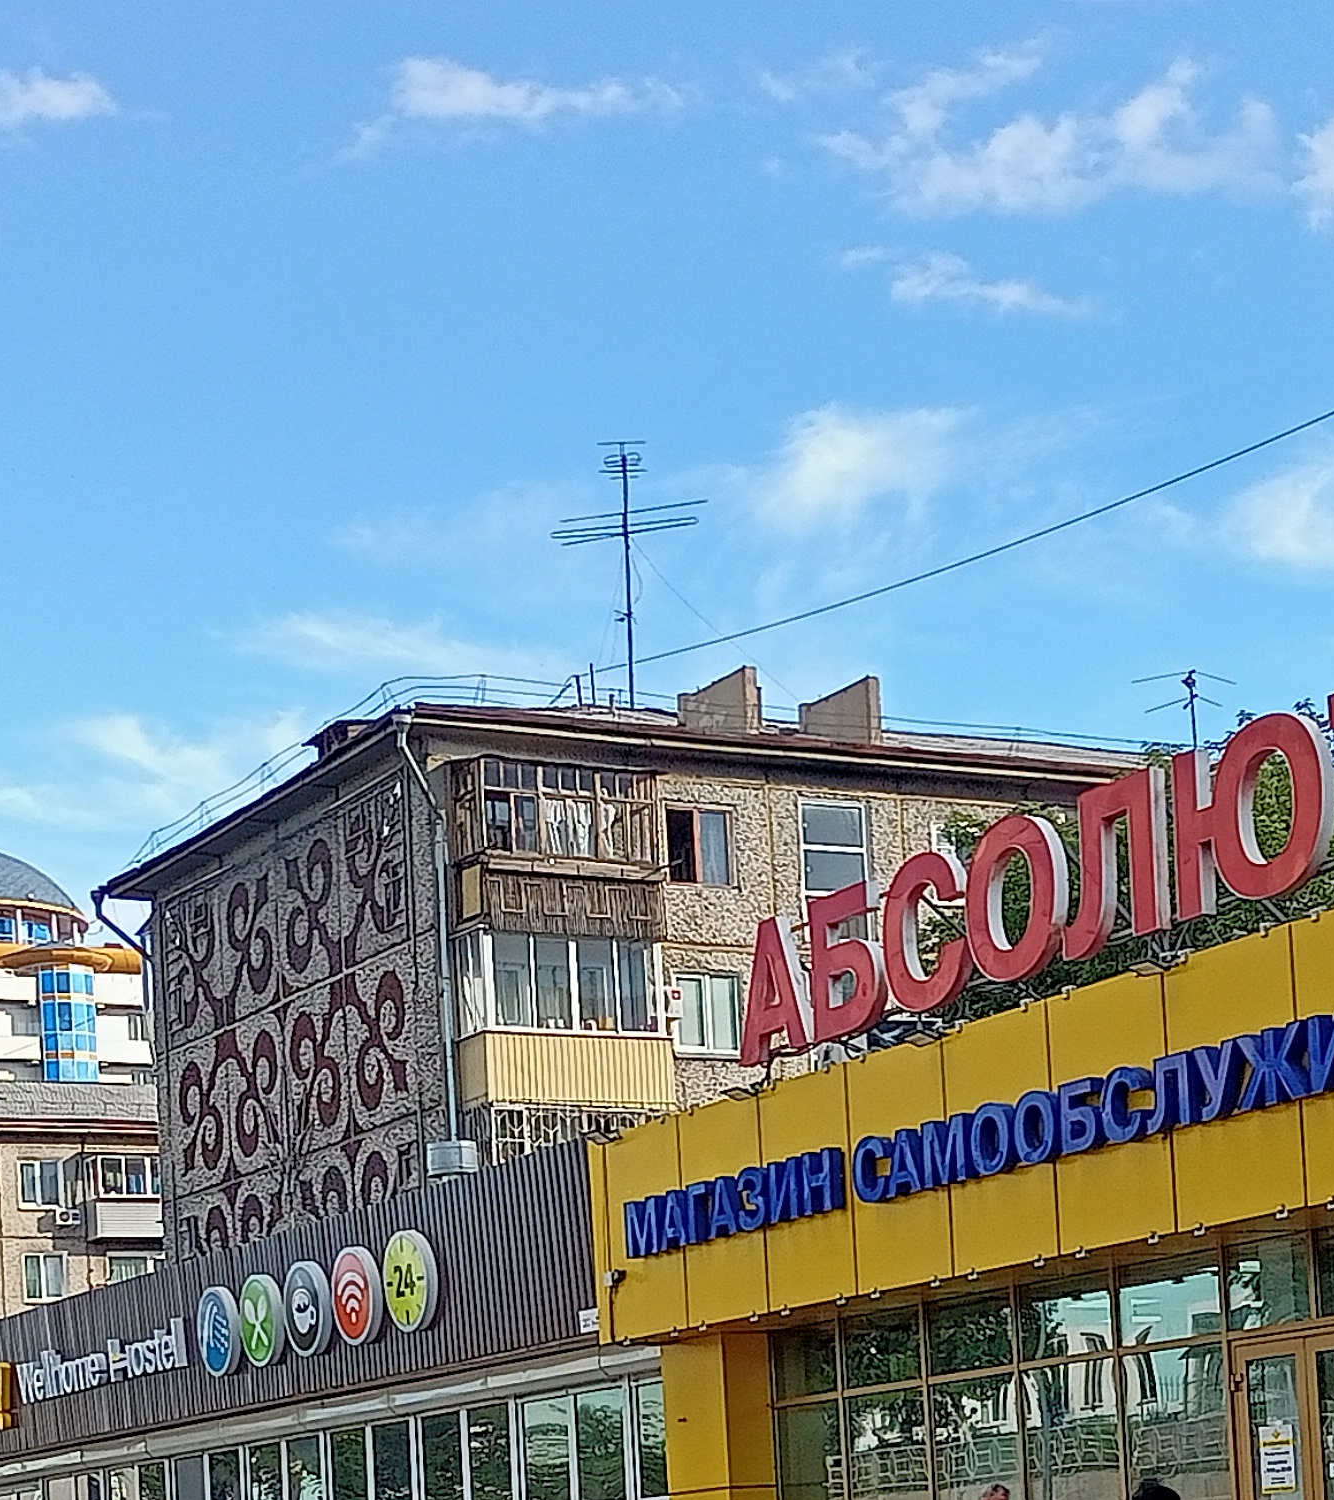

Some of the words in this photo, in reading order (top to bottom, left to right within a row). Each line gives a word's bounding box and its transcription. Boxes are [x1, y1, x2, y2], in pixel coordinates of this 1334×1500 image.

[624, 1147, 845, 1259] МАГАЗИН
[16, 1350, 108, 1405] Wellhome
[107, 1317, 189, 1383] Hostel
